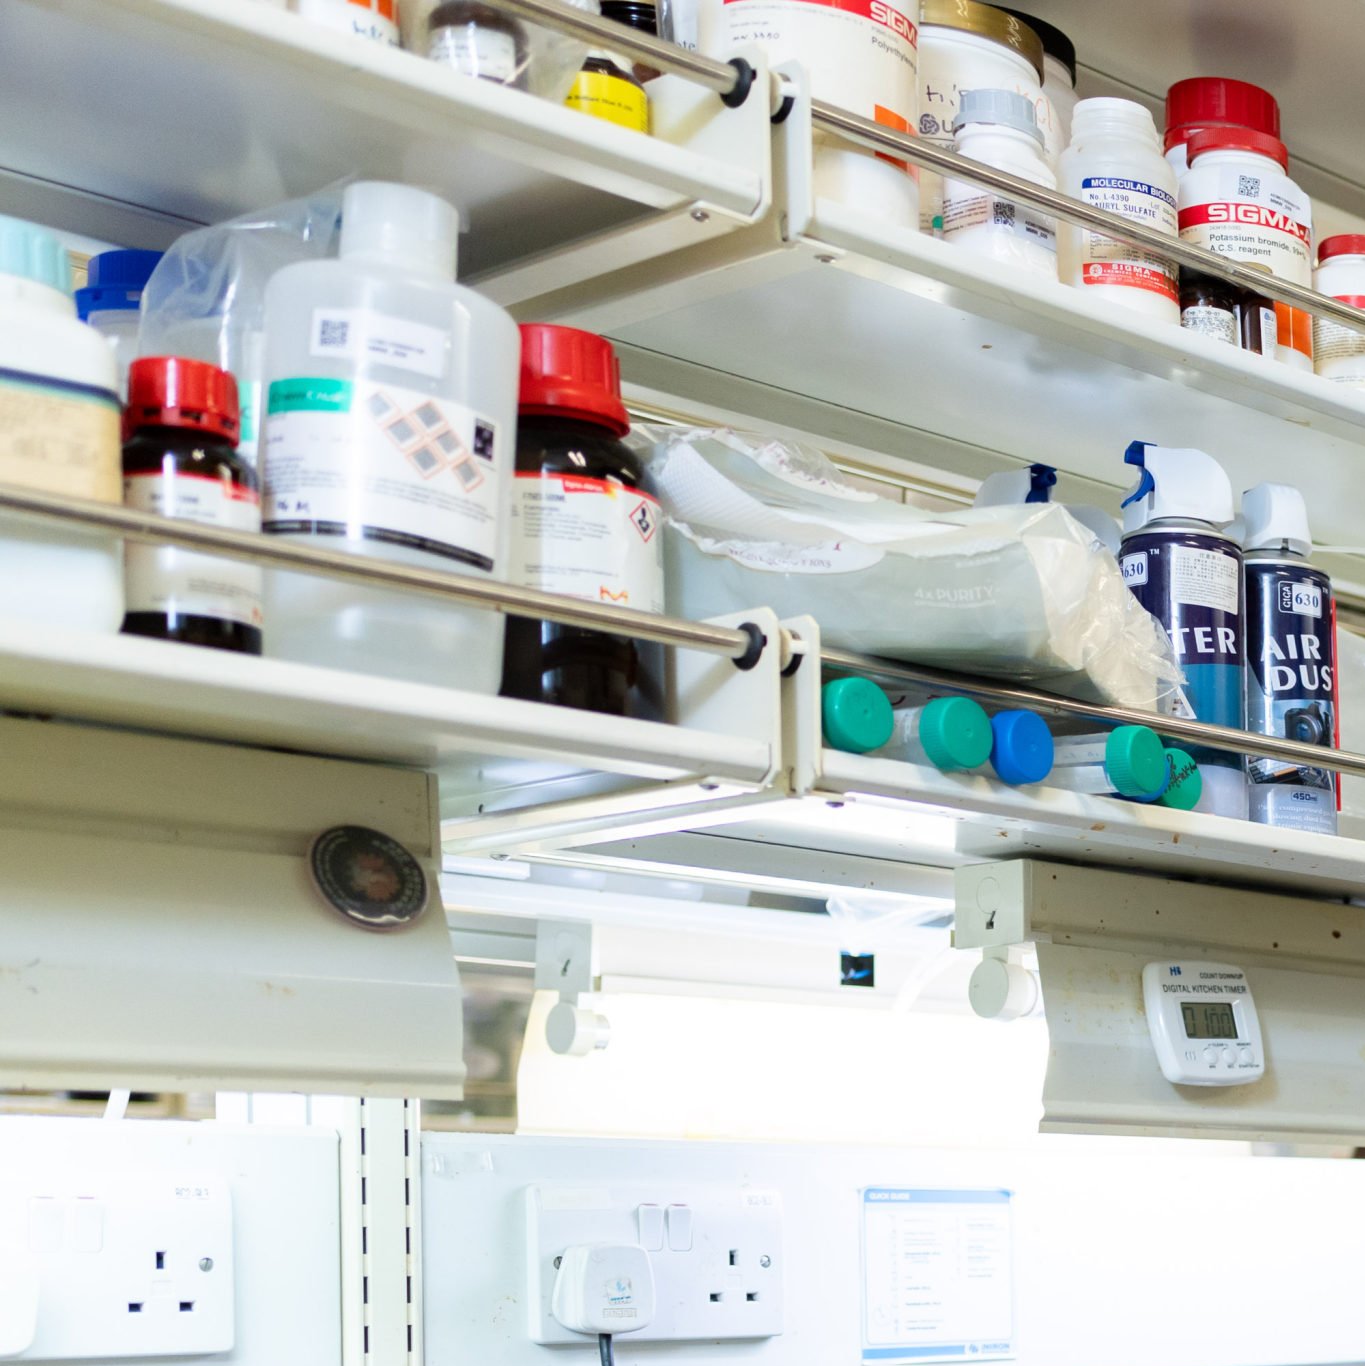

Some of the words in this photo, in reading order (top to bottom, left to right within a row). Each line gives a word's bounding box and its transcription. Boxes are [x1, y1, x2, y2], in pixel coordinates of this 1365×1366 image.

[870, 1, 917, 49] SIGM
[1091, 179, 1149, 194] MOLECULAR
[1123, 203, 1157, 219] SULFATE
[1209, 233, 1256, 243] Potassium
[1257, 235, 1292, 253] bromide,
[1238, 244, 1272, 256] reagent
[1111, 263, 1152, 276] SIGMA
[1123, 561, 1144, 579] 630
[1282, 586, 1292, 609] GIGA
[1294, 592, 1319, 609] 630
[1260, 634, 1322, 662] AIR
[1267, 664, 1334, 692] DUS
[1162, 984, 1191, 994] DIGITAL
[1191, 985, 1224, 994] KITCHEN
[1224, 985, 1248, 994] TIMER
